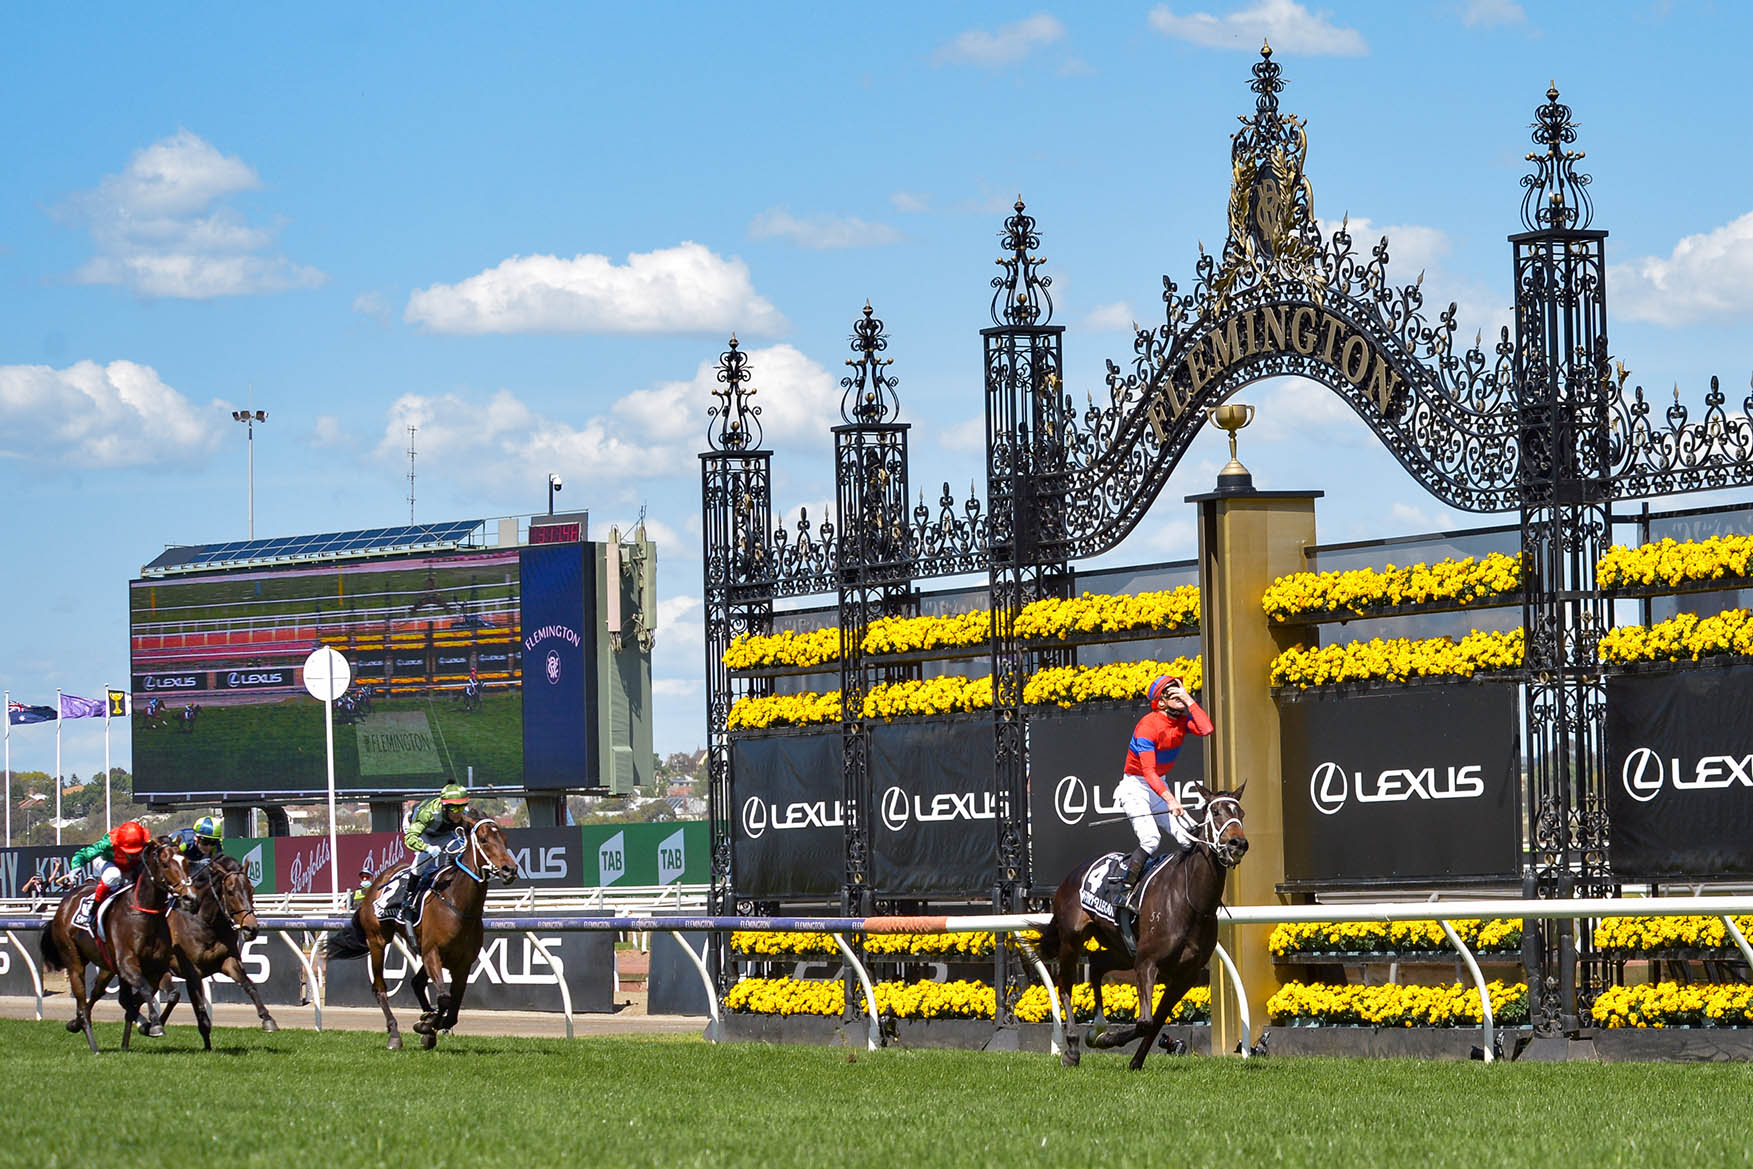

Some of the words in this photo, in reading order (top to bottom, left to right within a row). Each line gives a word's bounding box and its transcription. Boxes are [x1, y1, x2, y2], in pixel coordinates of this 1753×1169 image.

[1146, 306, 1401, 448] FLEMINGTON
[525, 625, 580, 651] FLEMINGTON
[157, 676, 197, 688] LEXUS
[241, 672, 283, 684] LEXUS
[1355, 765, 1485, 802] LEXUS
[1671, 754, 1753, 790] LEX
[290, 838, 330, 893] Penfolds
[506, 846, 568, 880] XUS
[601, 850, 622, 871] TAB
[661, 848, 682, 870] TAB
